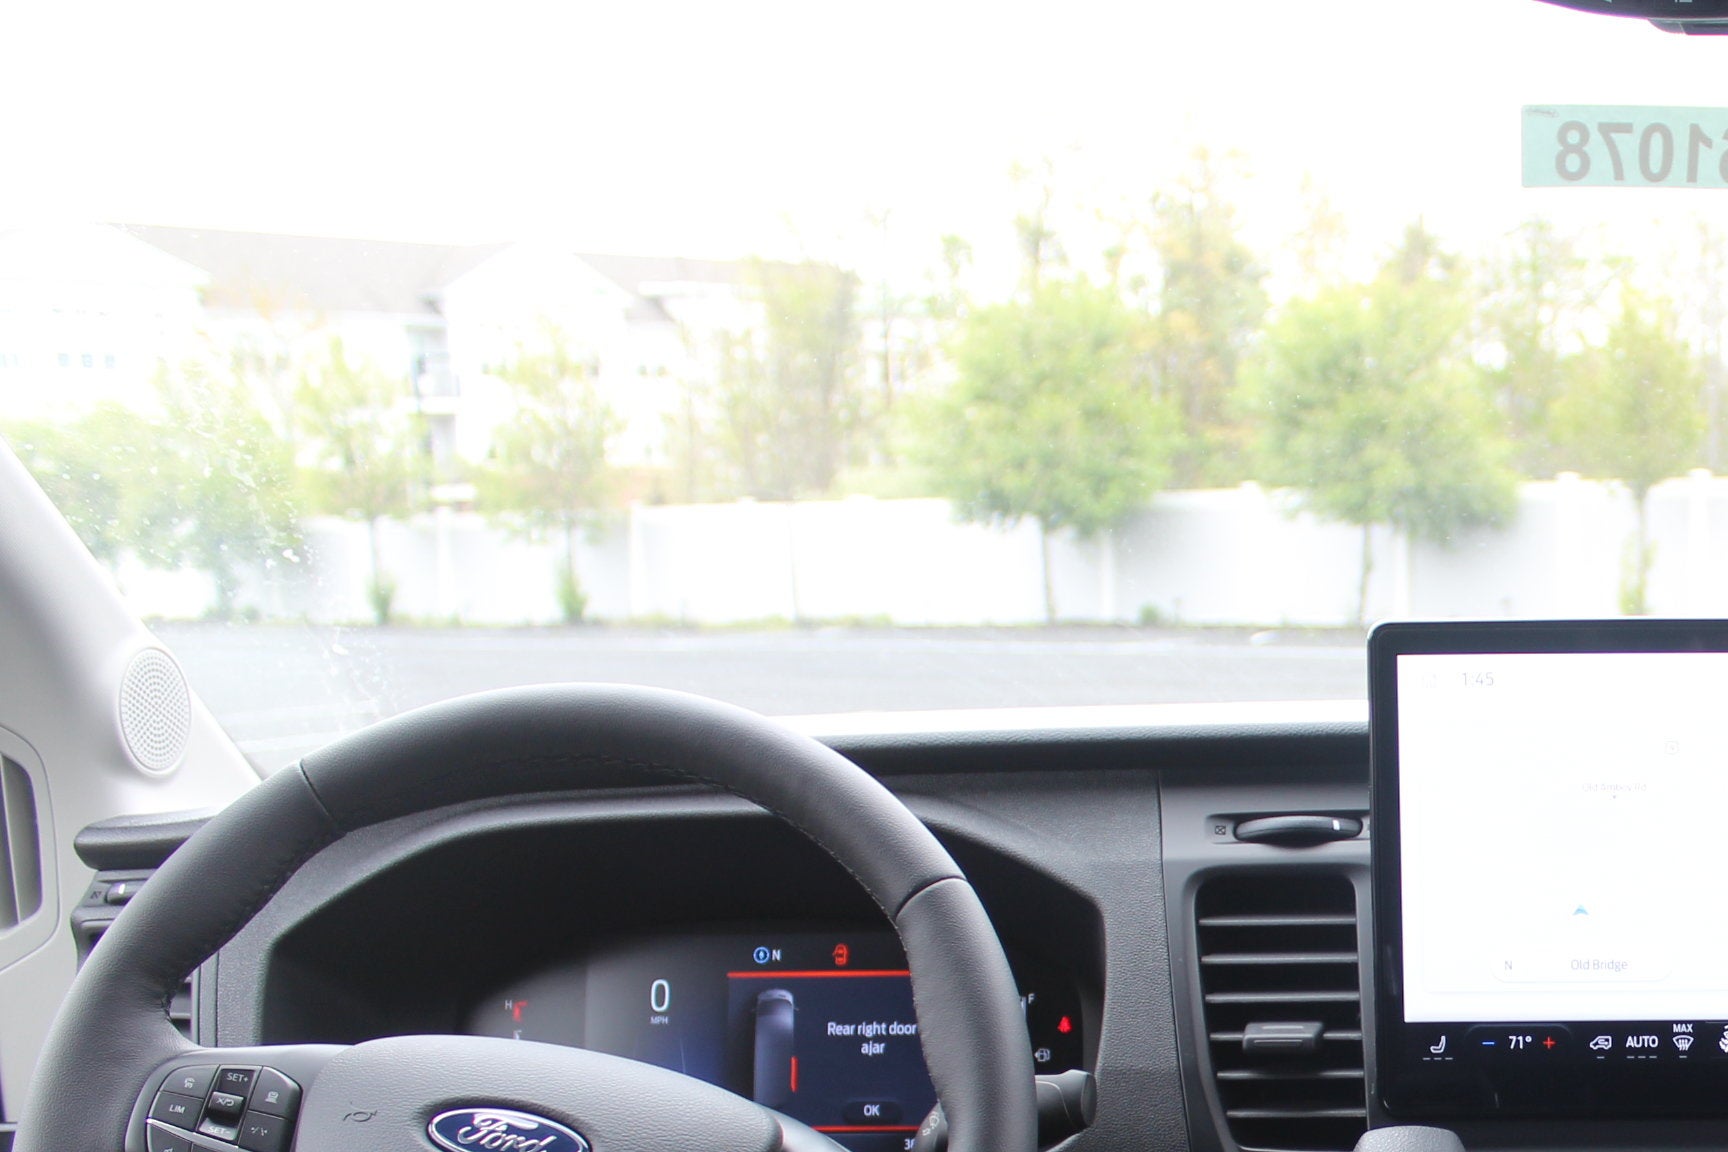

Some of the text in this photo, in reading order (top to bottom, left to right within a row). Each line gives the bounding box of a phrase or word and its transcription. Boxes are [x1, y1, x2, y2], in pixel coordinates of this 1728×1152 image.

[771, 949, 782, 962] N
[1570, 958, 1629, 973] Old Bridge
[650, 978, 670, 1013] 0
[1027, 993, 1035, 1005] F
[504, 999, 513, 1010] H
[650, 1015, 669, 1025] MPH
[827, 1020, 918, 1039] Rear right door
[1673, 1023, 1693, 1034] MAX
[860, 1040, 886, 1056] ajar
[1625, 1034, 1659, 1049] AUTO
[168, 1104, 186, 1114] LIM
[863, 1104, 880, 1117] OK
